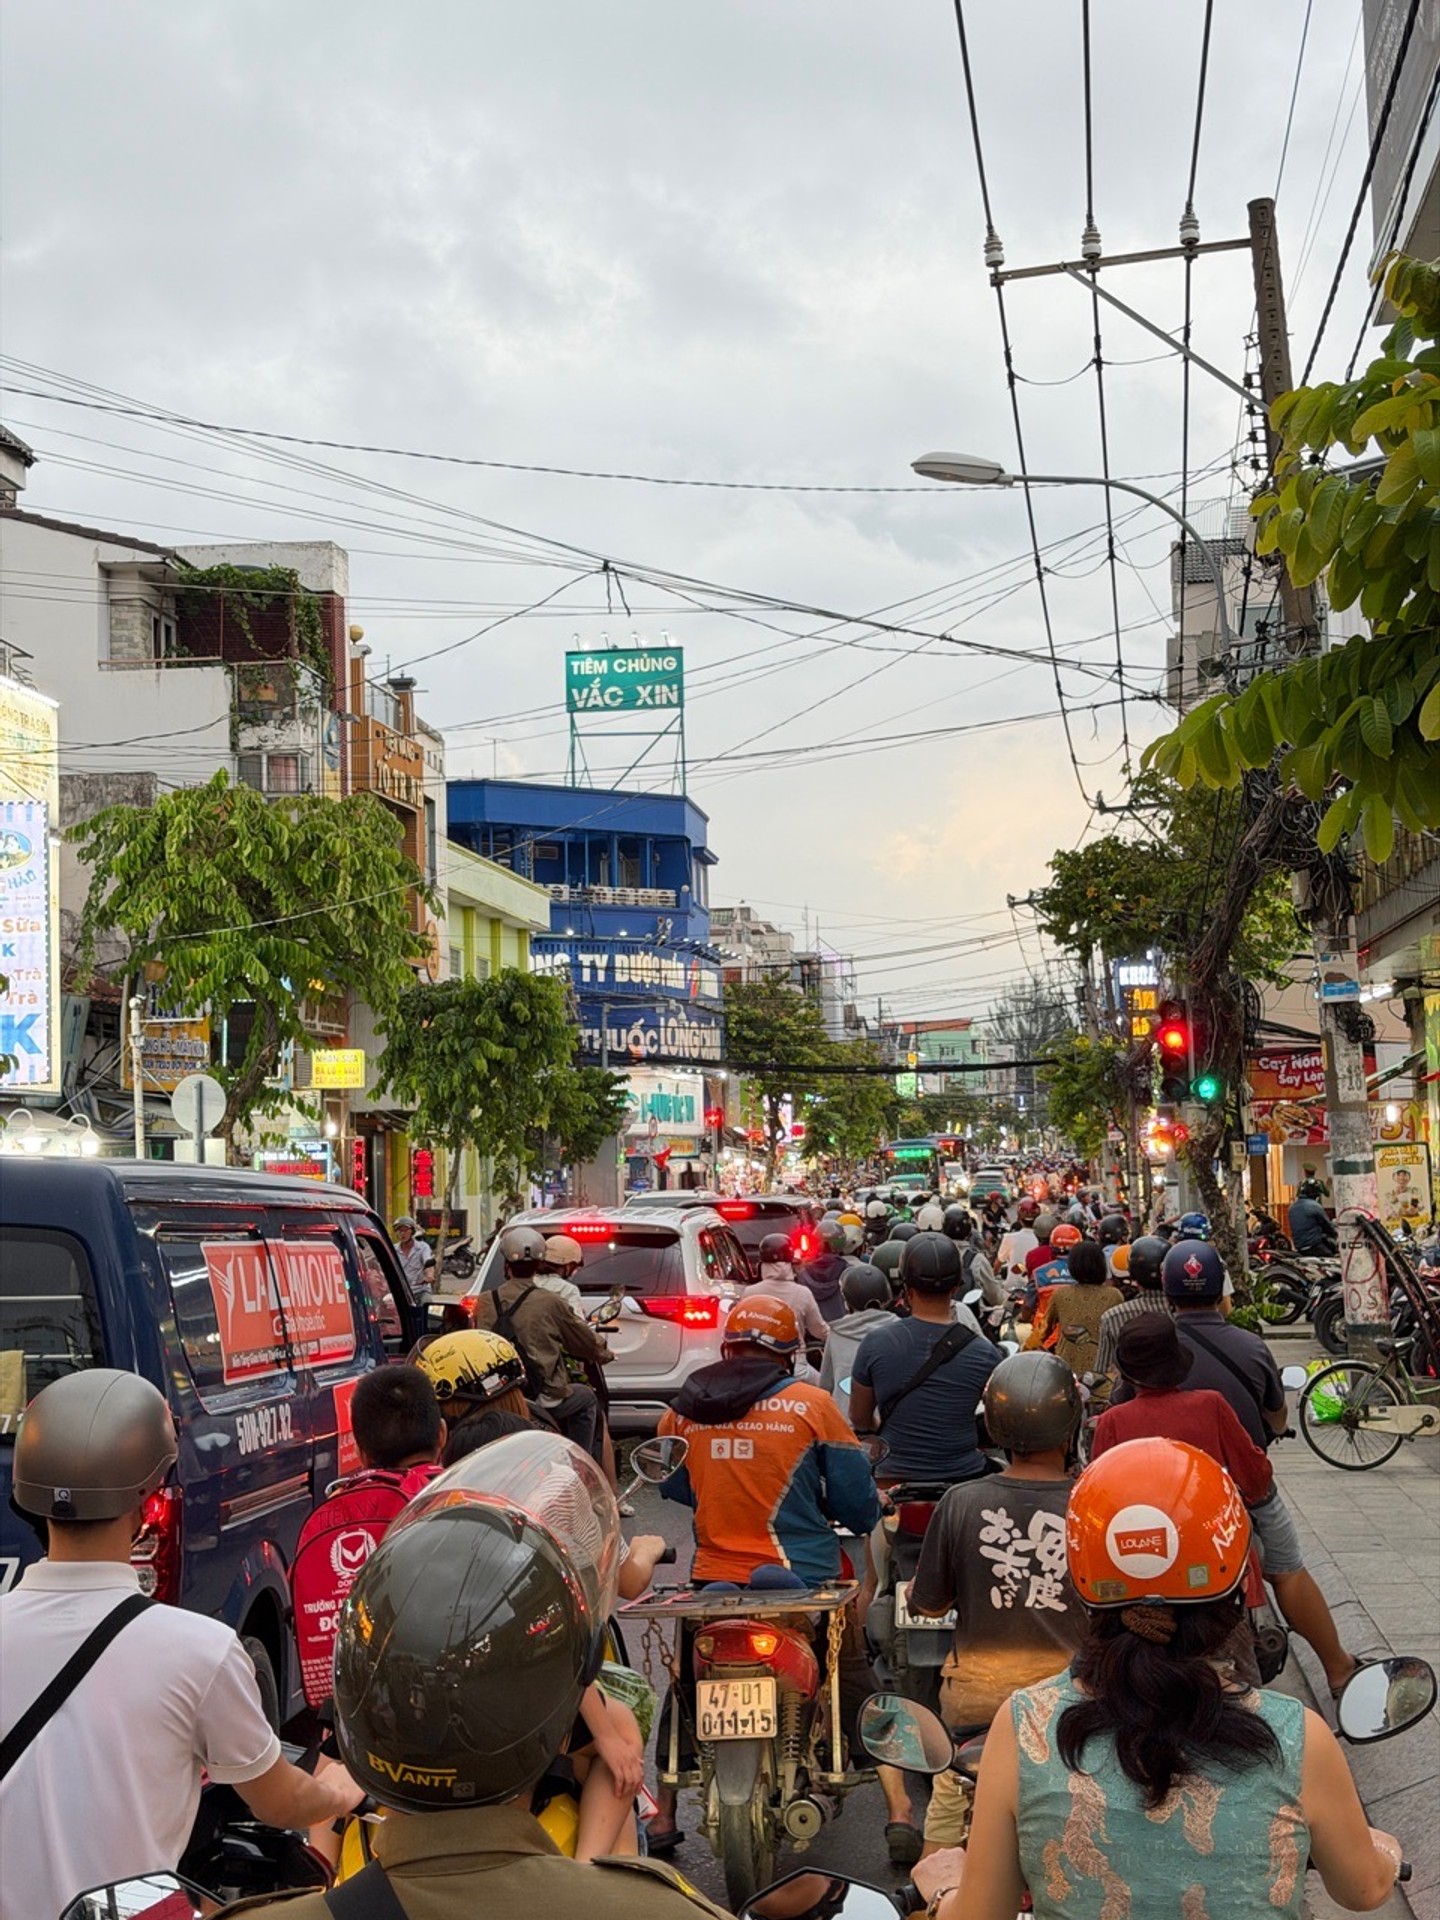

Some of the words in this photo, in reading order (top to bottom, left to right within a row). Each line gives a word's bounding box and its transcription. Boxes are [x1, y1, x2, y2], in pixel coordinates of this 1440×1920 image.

[571, 657, 608, 675] TIÊM
[613, 653, 677, 673] CHỦNG
[571, 677, 624, 708] VẮC
[636, 684, 679, 705] XIN
[2, 917, 41, 933] Sữa
[579, 954, 608, 982] TY
[615, 951, 660, 988] DƯỢC
[580, 1017, 658, 1055] THUỐC
[660, 1017, 699, 1058] LONG
[1259, 1057, 1289, 1074] Cay
[1278, 1073, 1300, 1087] Say
[737, 1421, 763, 1431] GIAO
[766, 1421, 795, 1433] HÀNG
